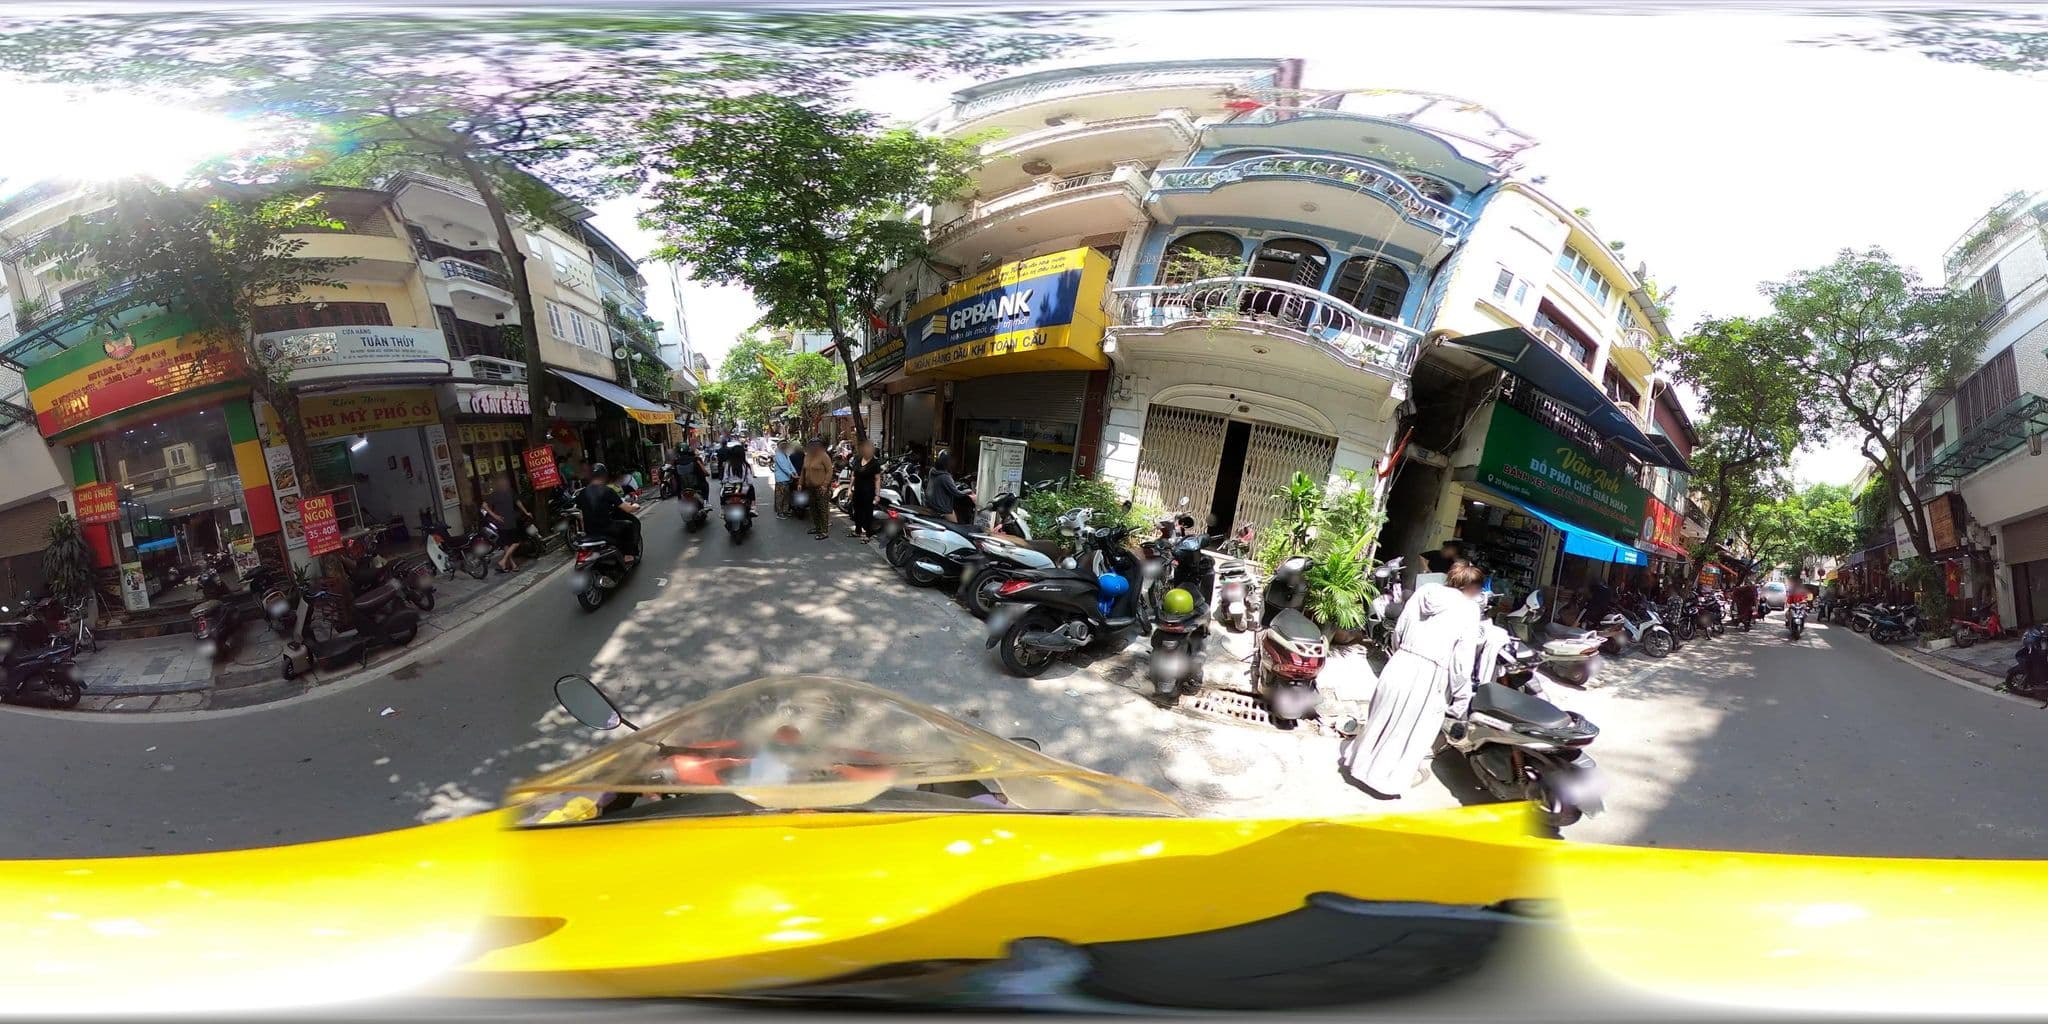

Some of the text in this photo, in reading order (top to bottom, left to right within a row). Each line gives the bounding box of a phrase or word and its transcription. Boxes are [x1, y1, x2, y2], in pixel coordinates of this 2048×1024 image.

[950, 289, 1034, 331] GPBANK
[1556, 448, 1593, 478] Vân
[1550, 467, 1571, 487] PHA
[304, 508, 333, 523] NGON
